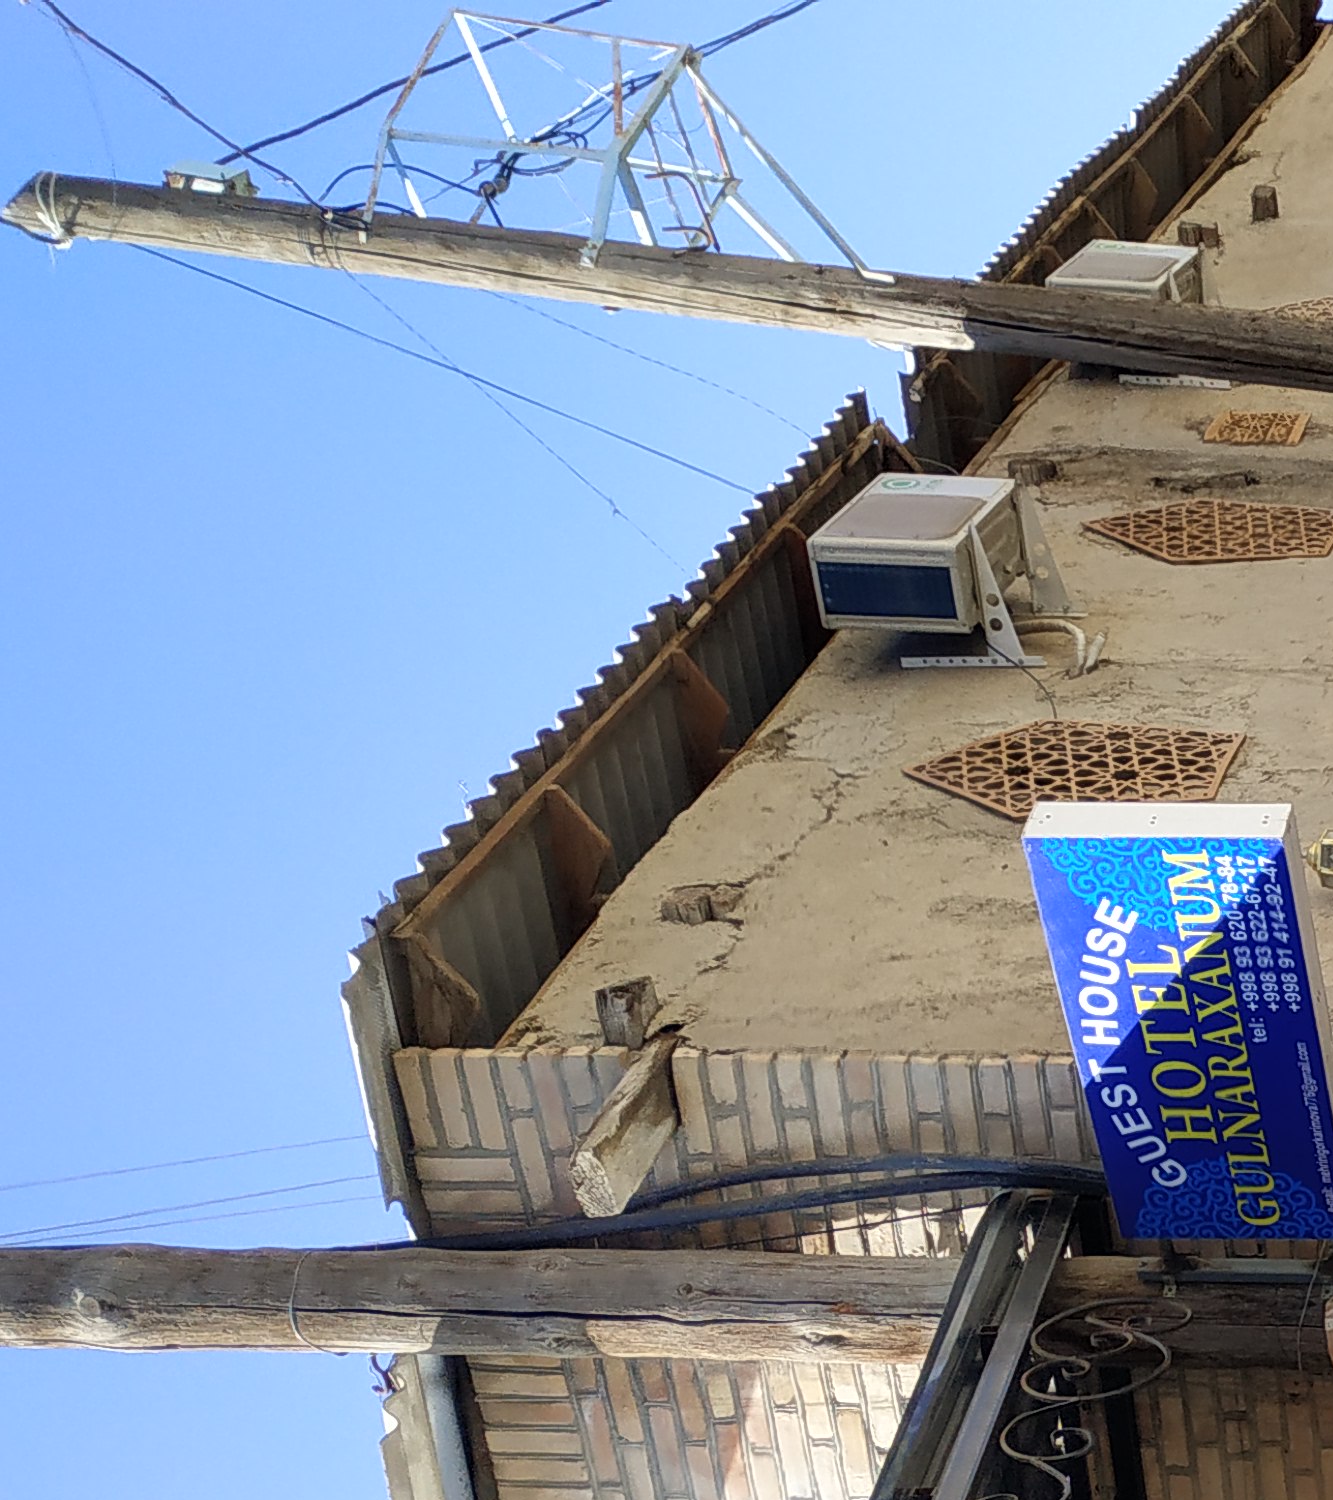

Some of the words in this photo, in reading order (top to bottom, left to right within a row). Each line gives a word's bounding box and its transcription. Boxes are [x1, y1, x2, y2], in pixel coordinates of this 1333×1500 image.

[1214, 855, 1248, 941] 620-78-84
[1236, 855, 1269, 942] 622-67-17
[1257, 856, 1290, 944] 414-92-47
[1079, 899, 1139, 1045] HOUSE
[1233, 946, 1253, 968] 93
[1255, 946, 1274, 969] 93
[1275, 947, 1295, 969] 91
[1238, 971, 1260, 1012] +998
[1260, 971, 1280, 1012] +998
[1280, 972, 1301, 1013] +998
[1126, 944, 1218, 1144] HOTEL
[1163, 848, 1281, 1226] GULNARAXANUM
[1248, 1017, 1268, 1043] tel:
[1091, 1058, 1187, 1188] GUEST
